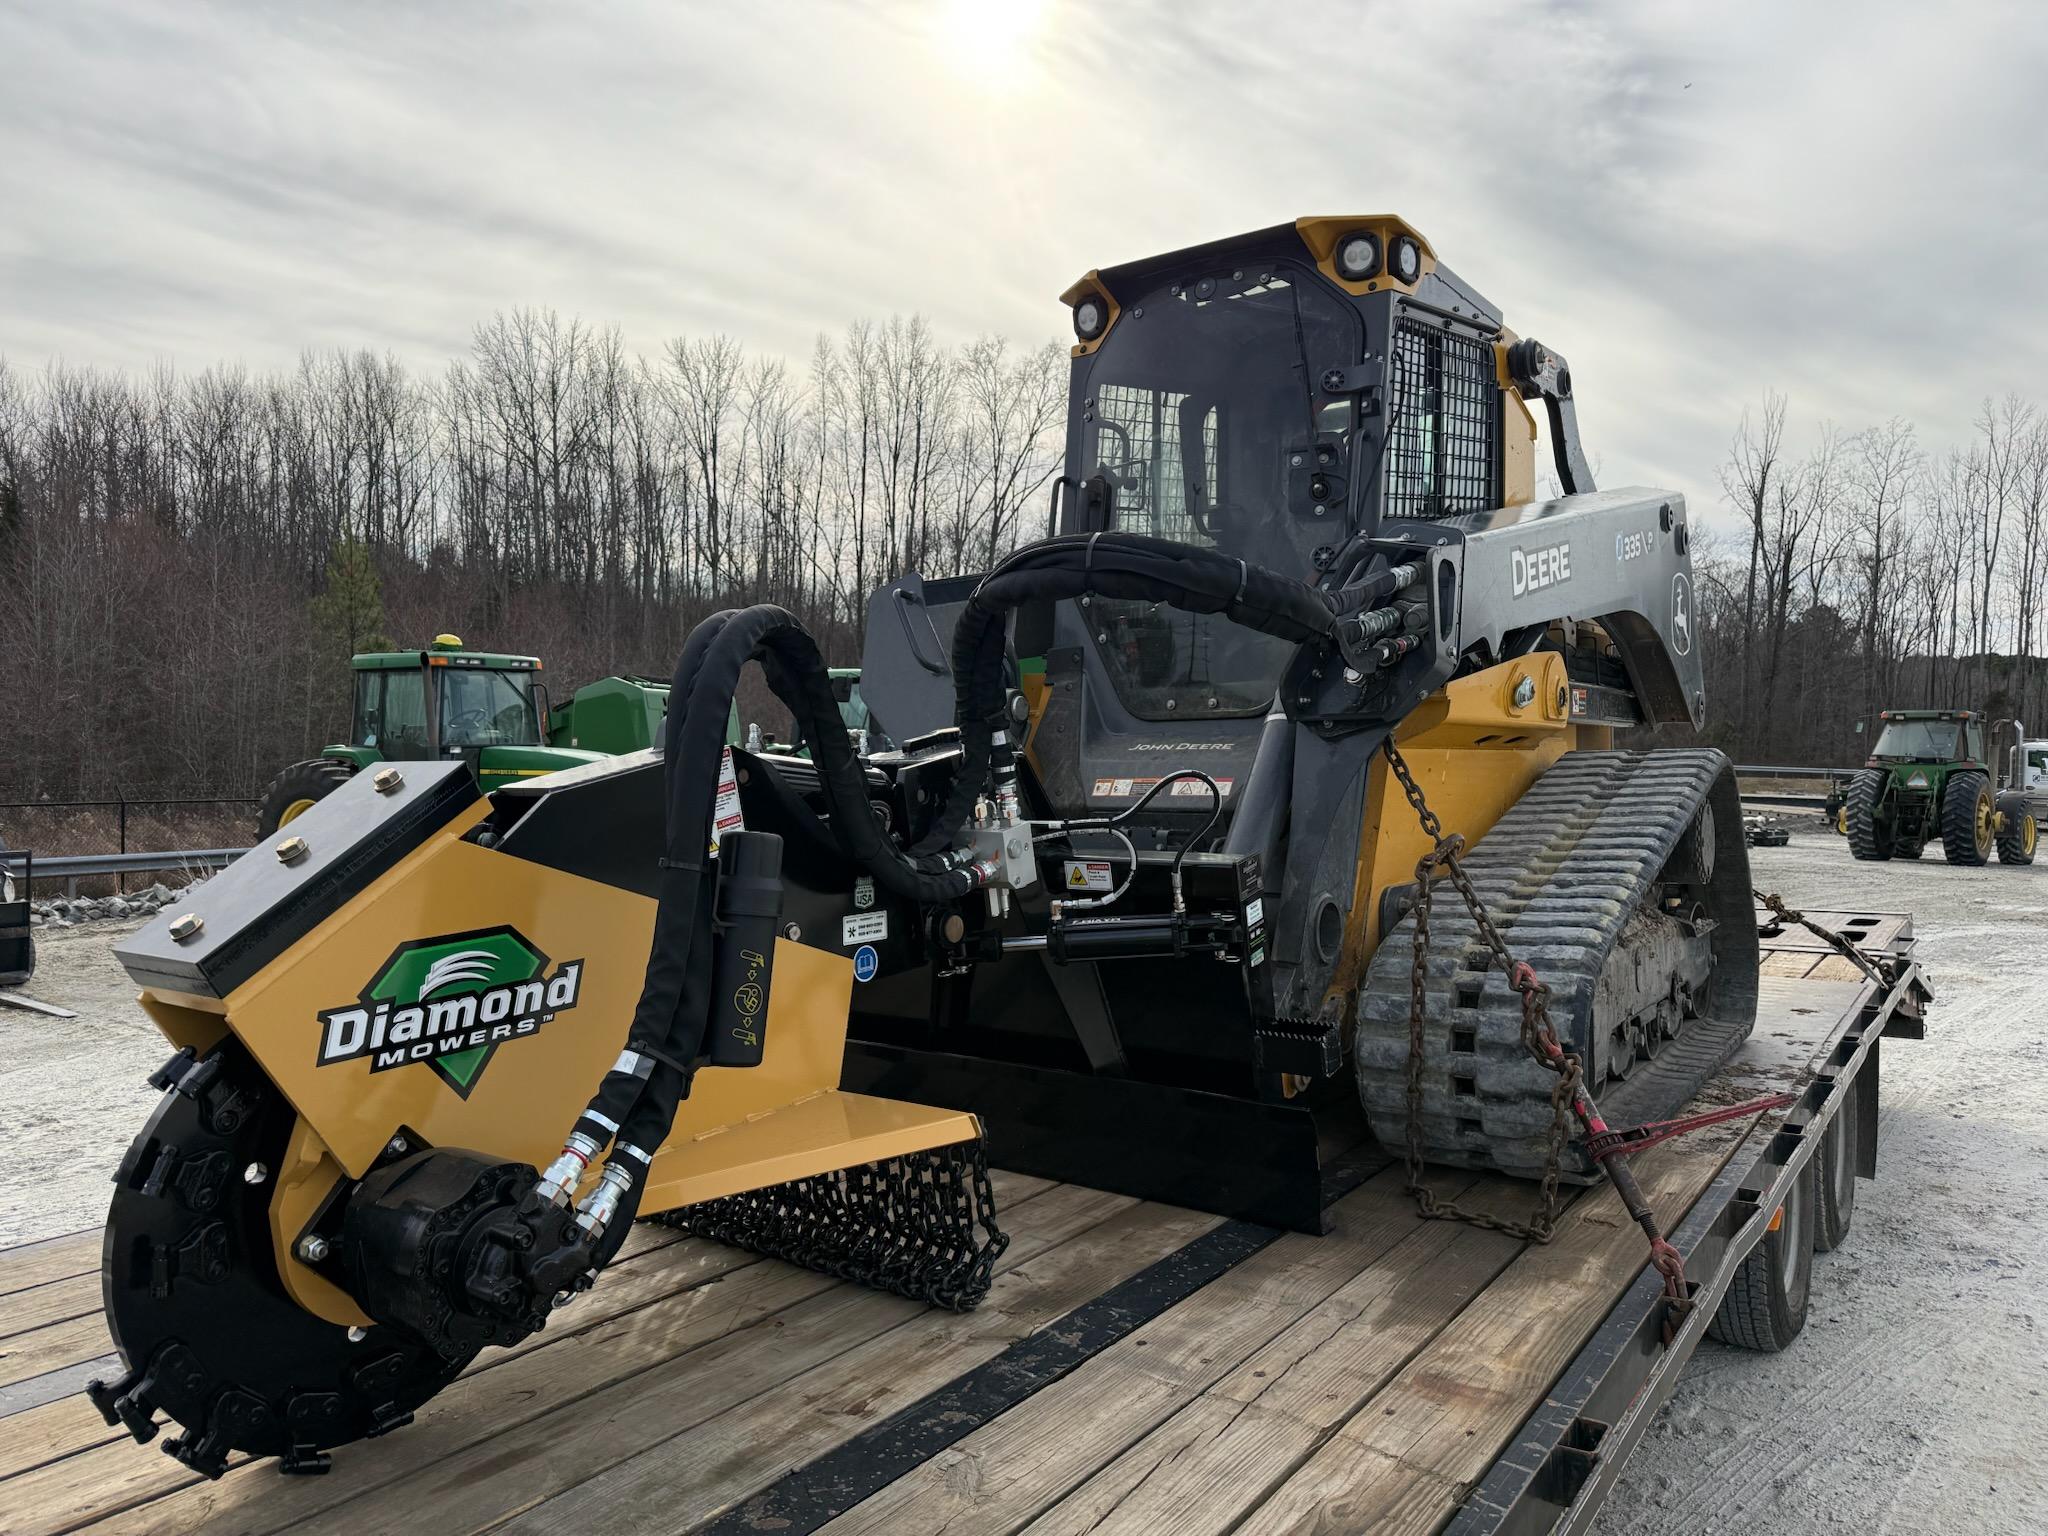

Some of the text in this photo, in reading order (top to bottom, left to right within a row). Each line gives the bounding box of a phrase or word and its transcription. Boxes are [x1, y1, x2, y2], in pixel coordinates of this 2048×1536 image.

[1511, 544, 1571, 597] DEERE
[1128, 742, 1234, 751] JOHN DEERE
[324, 964, 579, 1059] Diamond
[377, 1018, 535, 1067] MOWERS
